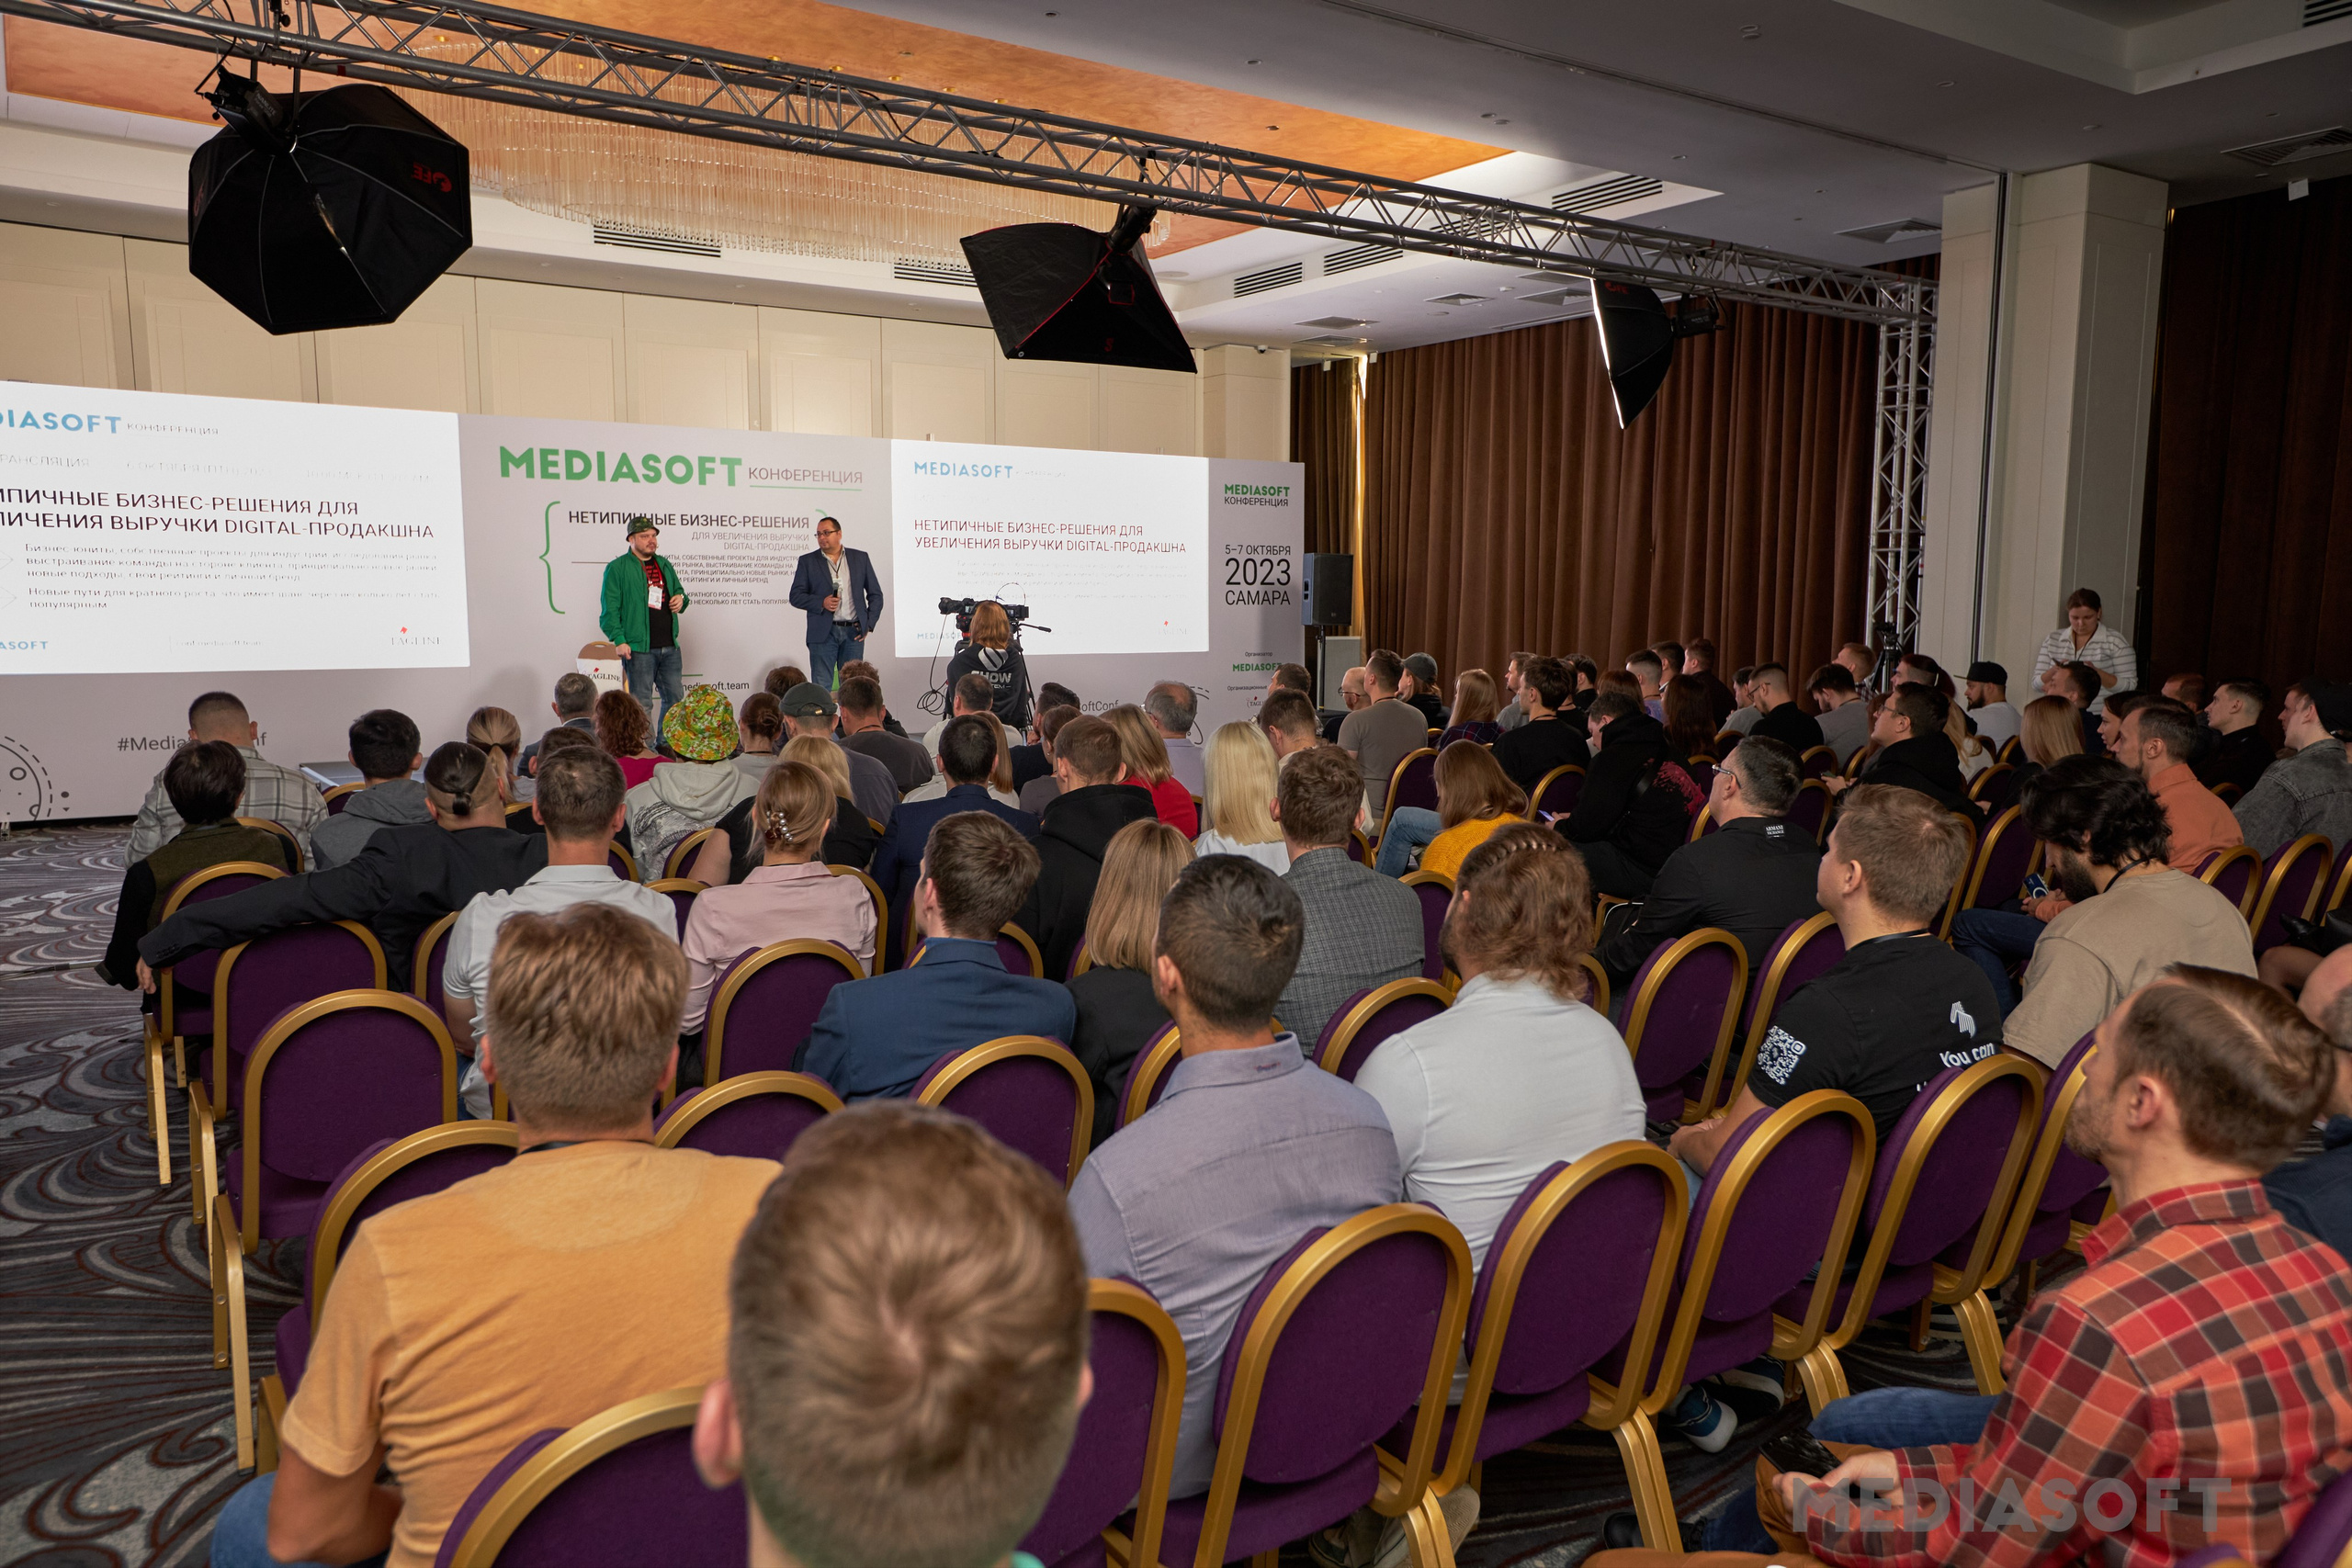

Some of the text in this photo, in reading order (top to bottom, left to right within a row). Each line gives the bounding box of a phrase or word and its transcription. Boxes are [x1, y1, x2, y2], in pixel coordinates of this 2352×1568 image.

[0, 409, 219, 435] IASOFT КОНФЕРЕНЦИЯ
[499, 446, 863, 487] MEDIASOFT КОНФЕРЕНЦИЯ
[914, 461, 1012, 479] MEDIASOFT
[1225, 484, 1290, 497] MEDIASOFT
[0, 488, 358, 517] ПИЧНЫЕ БИЗНЕС-РЕШЕНИЯ ДЛЯ
[1225, 497, 1288, 507] КОНФЕРЕНЦИЯ
[110, 515, 218, 533] ВЫРУЧКИ
[225, 519, 434, 539] DIGITAL-ПРОДАКШНА
[680, 514, 809, 529] БИЗНЕС-РЕШЕНИЯ
[914, 520, 1143, 537] НЕТИПИЧНЫЕ БИЗНЕС-РЕШЕНИЯ ДЛЯ
[692, 532, 809, 542] ДЛЯ УВЕЛИЧЕНИЯ ВЫРУЧКИ
[915, 536, 1186, 554] УВЕЛИЧЕНИЯ ВЫРУЧКИ DIGITAL-ПРОДАКШНА
[724, 542, 809, 551] DIGITAL-ПРОДАКШНА
[1246, 545, 1291, 555] ОКТЯБРЯ
[1225, 558, 1291, 586] 2023
[1226, 590, 1291, 605] САМАРА
[588, 673, 621, 682] TAGLINE
[1081, 699, 1119, 712] oftConf
[1939, 1043, 1994, 1067] You can
